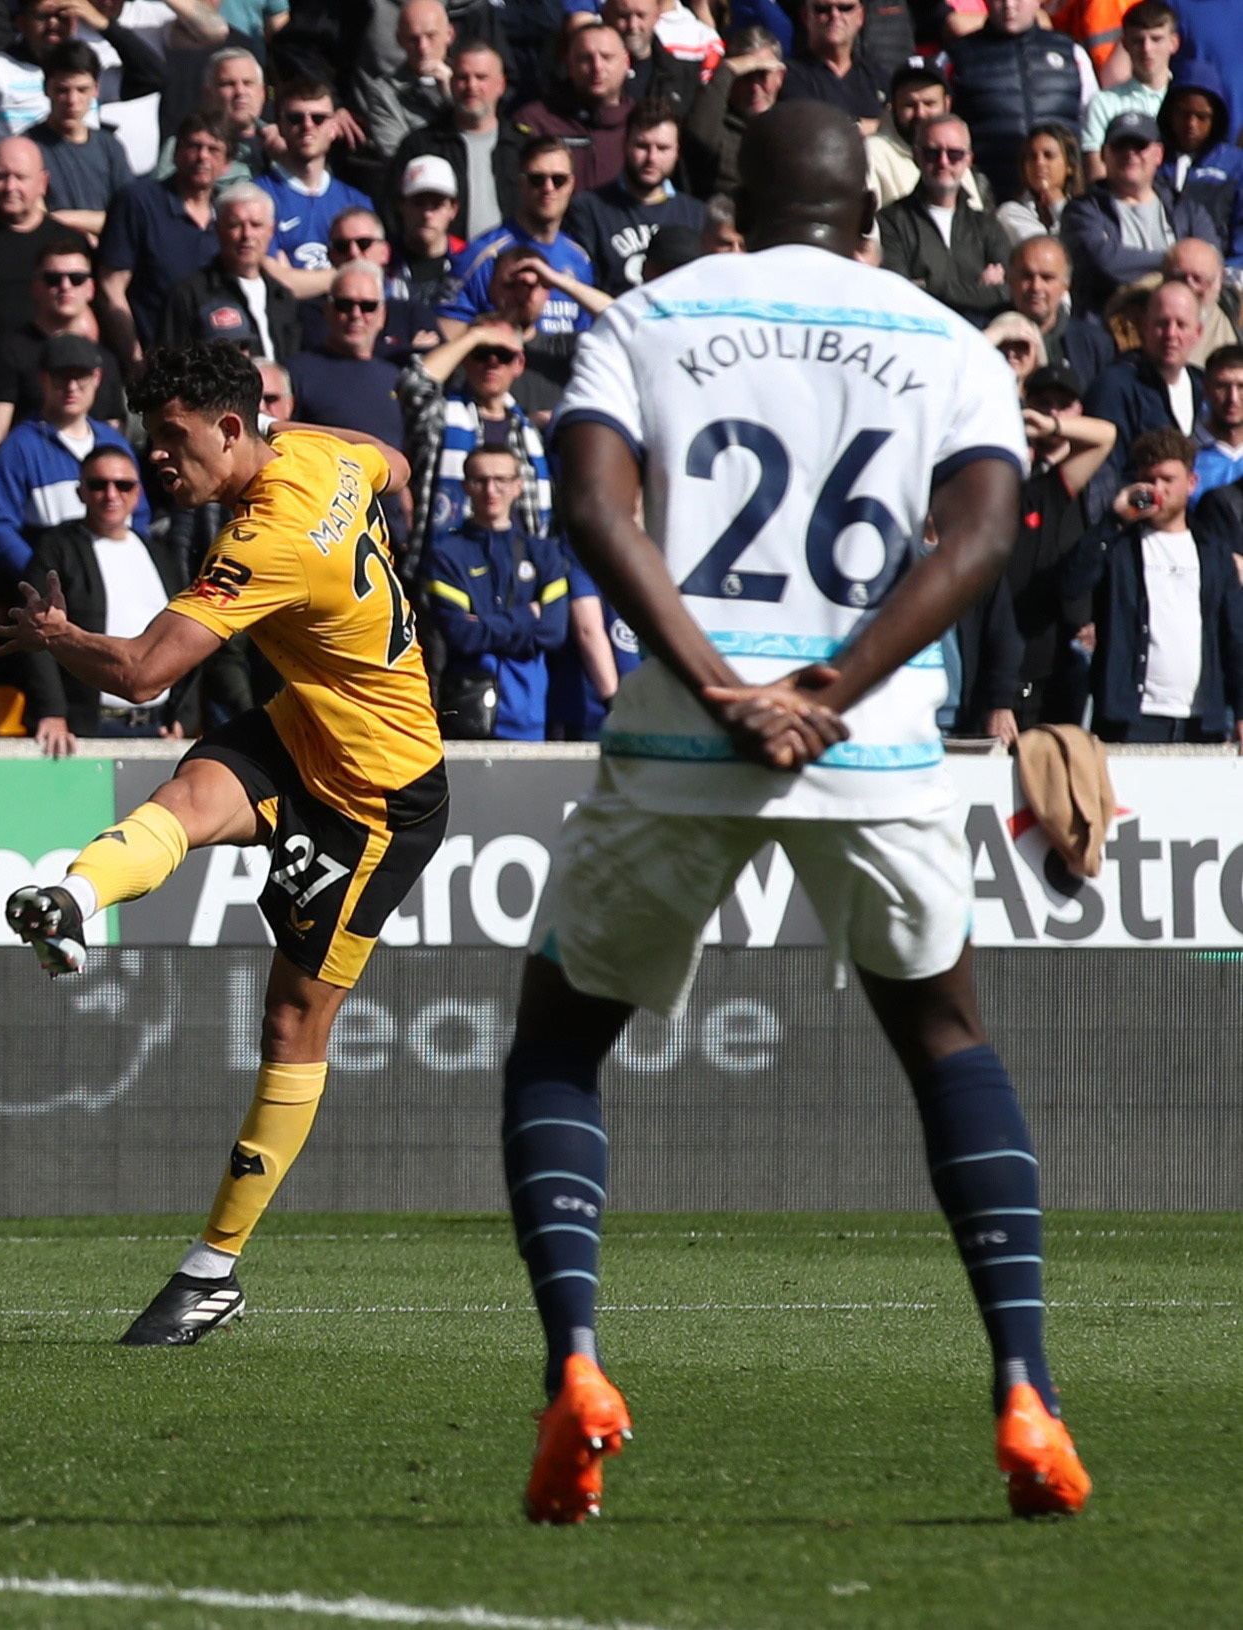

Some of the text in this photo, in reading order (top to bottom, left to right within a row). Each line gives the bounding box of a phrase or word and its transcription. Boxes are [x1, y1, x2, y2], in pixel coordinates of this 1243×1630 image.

[677, 327, 927, 397] KOULIBALY
[679, 418, 913, 610] 26
[270, 834, 352, 909] 27
[226, 964, 782, 1074] Leaue
